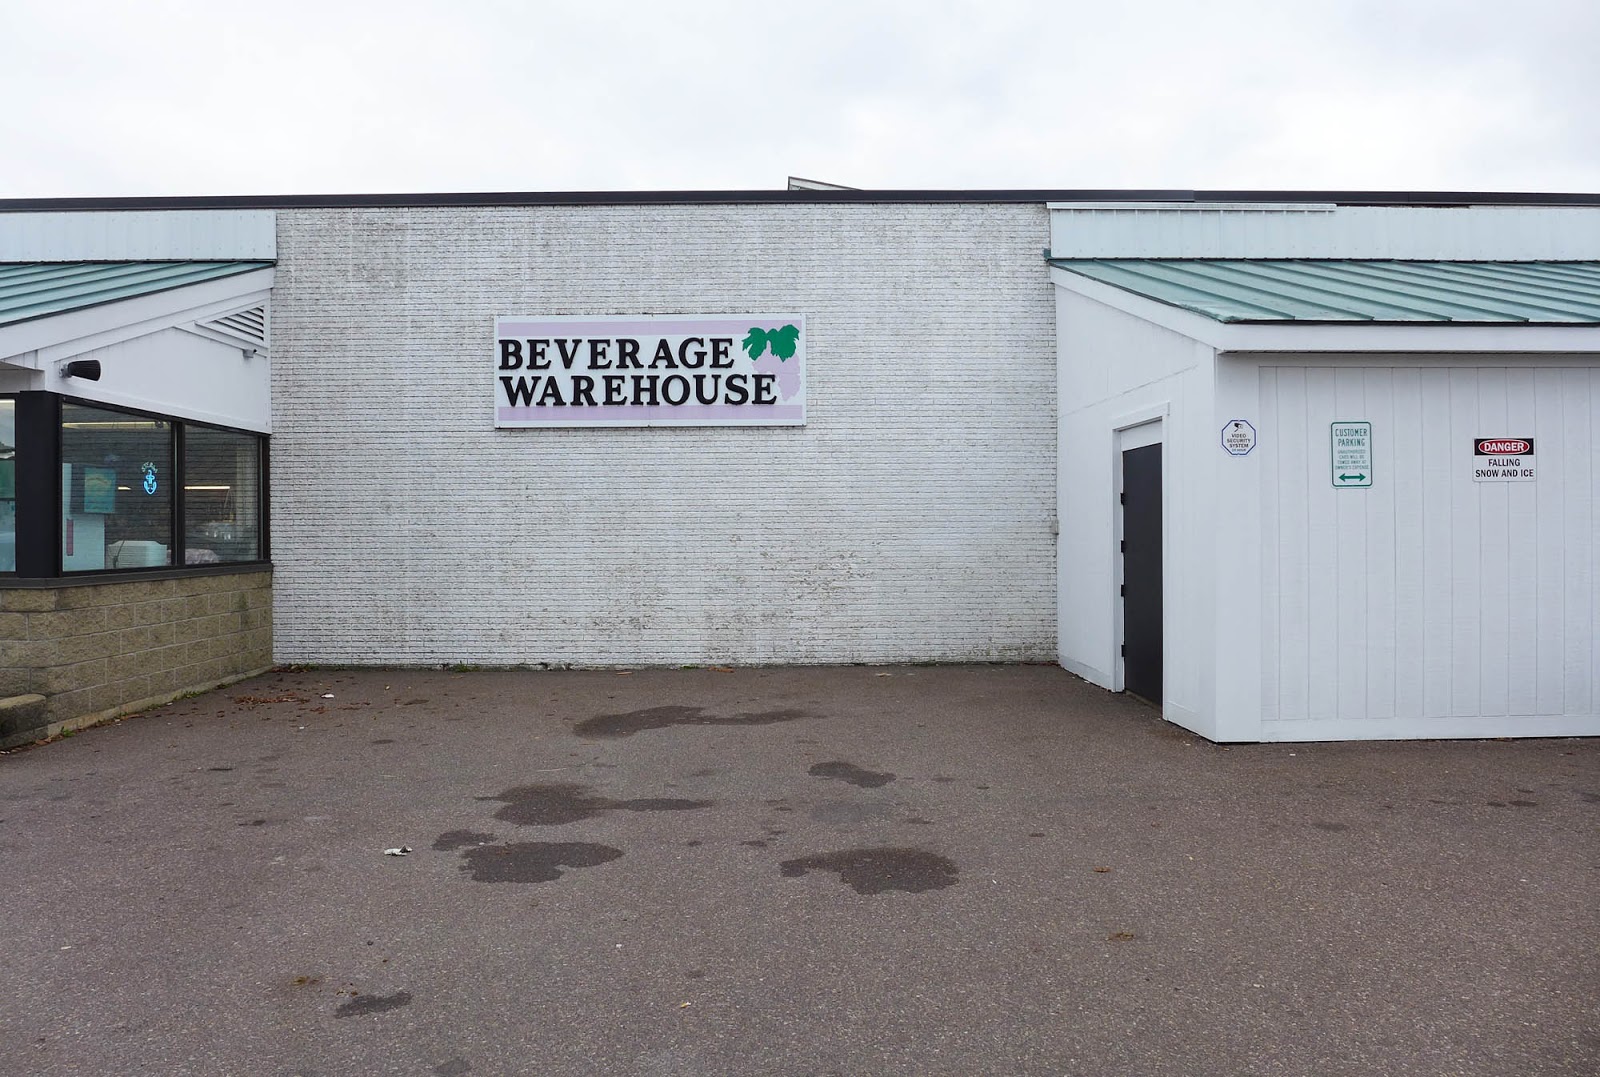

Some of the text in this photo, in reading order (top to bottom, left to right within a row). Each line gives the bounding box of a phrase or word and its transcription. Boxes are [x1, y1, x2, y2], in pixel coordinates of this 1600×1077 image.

[498, 337, 735, 370] BEVERAGE
[499, 373, 777, 407] WAREHOUSE
[1335, 428, 1368, 437] CUSTOMER
[1337, 438, 1365, 447] PARKING
[1484, 442, 1524, 452] DANGER
[1488, 458, 1520, 467] FALLING
[1475, 469, 1534, 478] SNOW AND ICE
